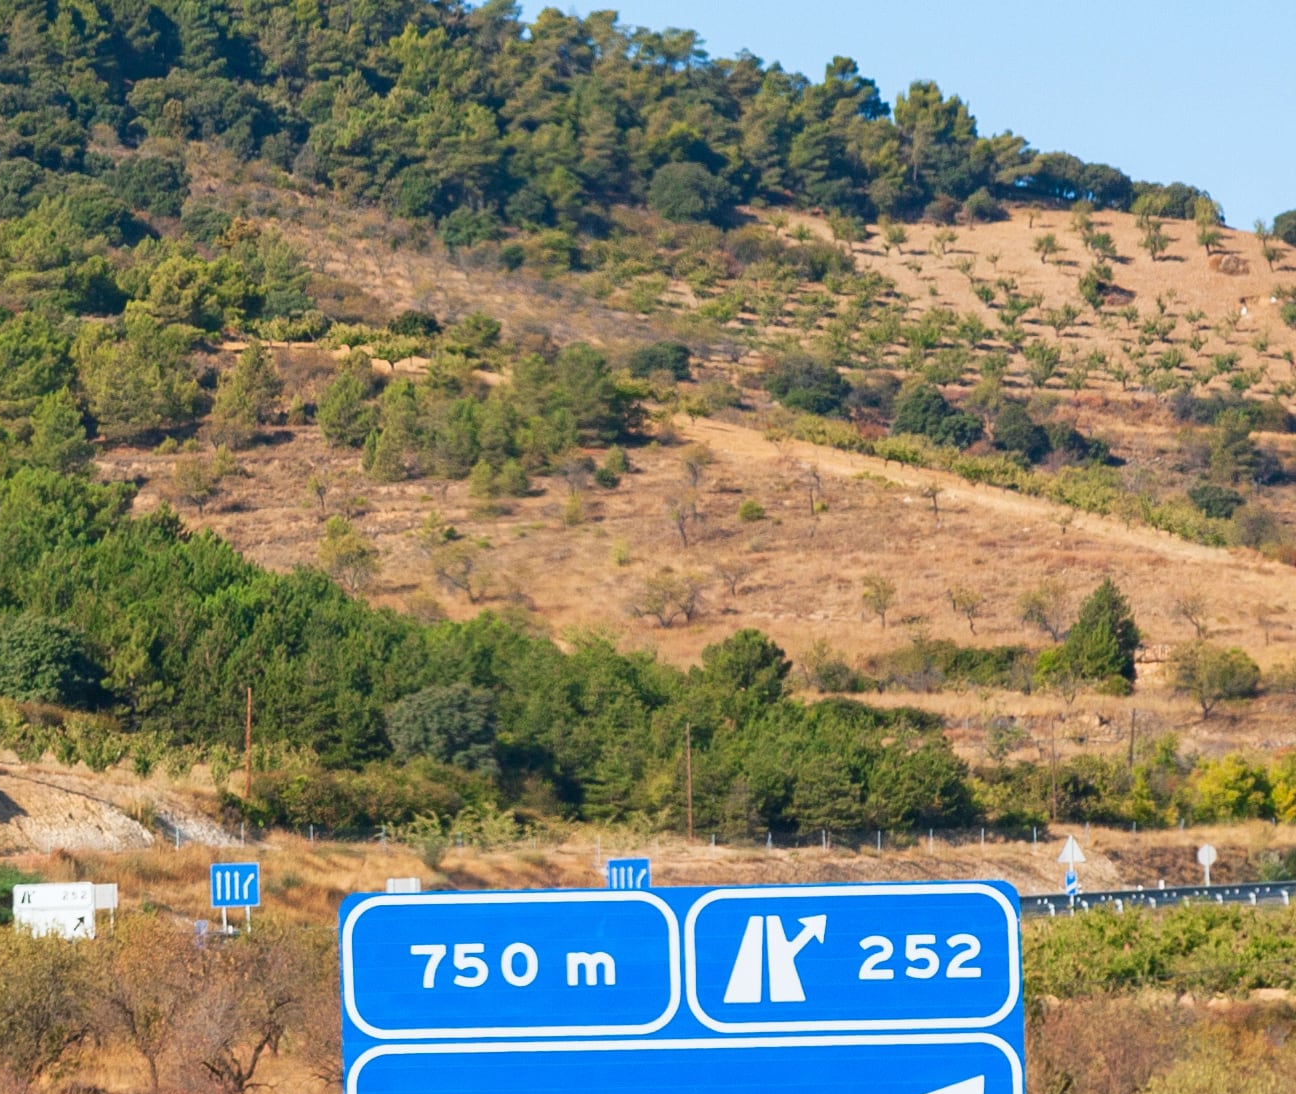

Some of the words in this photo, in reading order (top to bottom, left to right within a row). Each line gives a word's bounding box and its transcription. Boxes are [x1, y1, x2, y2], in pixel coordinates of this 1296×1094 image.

[410, 942, 539, 989] 750
[566, 950, 617, 987] m
[858, 933, 983, 981] 252
